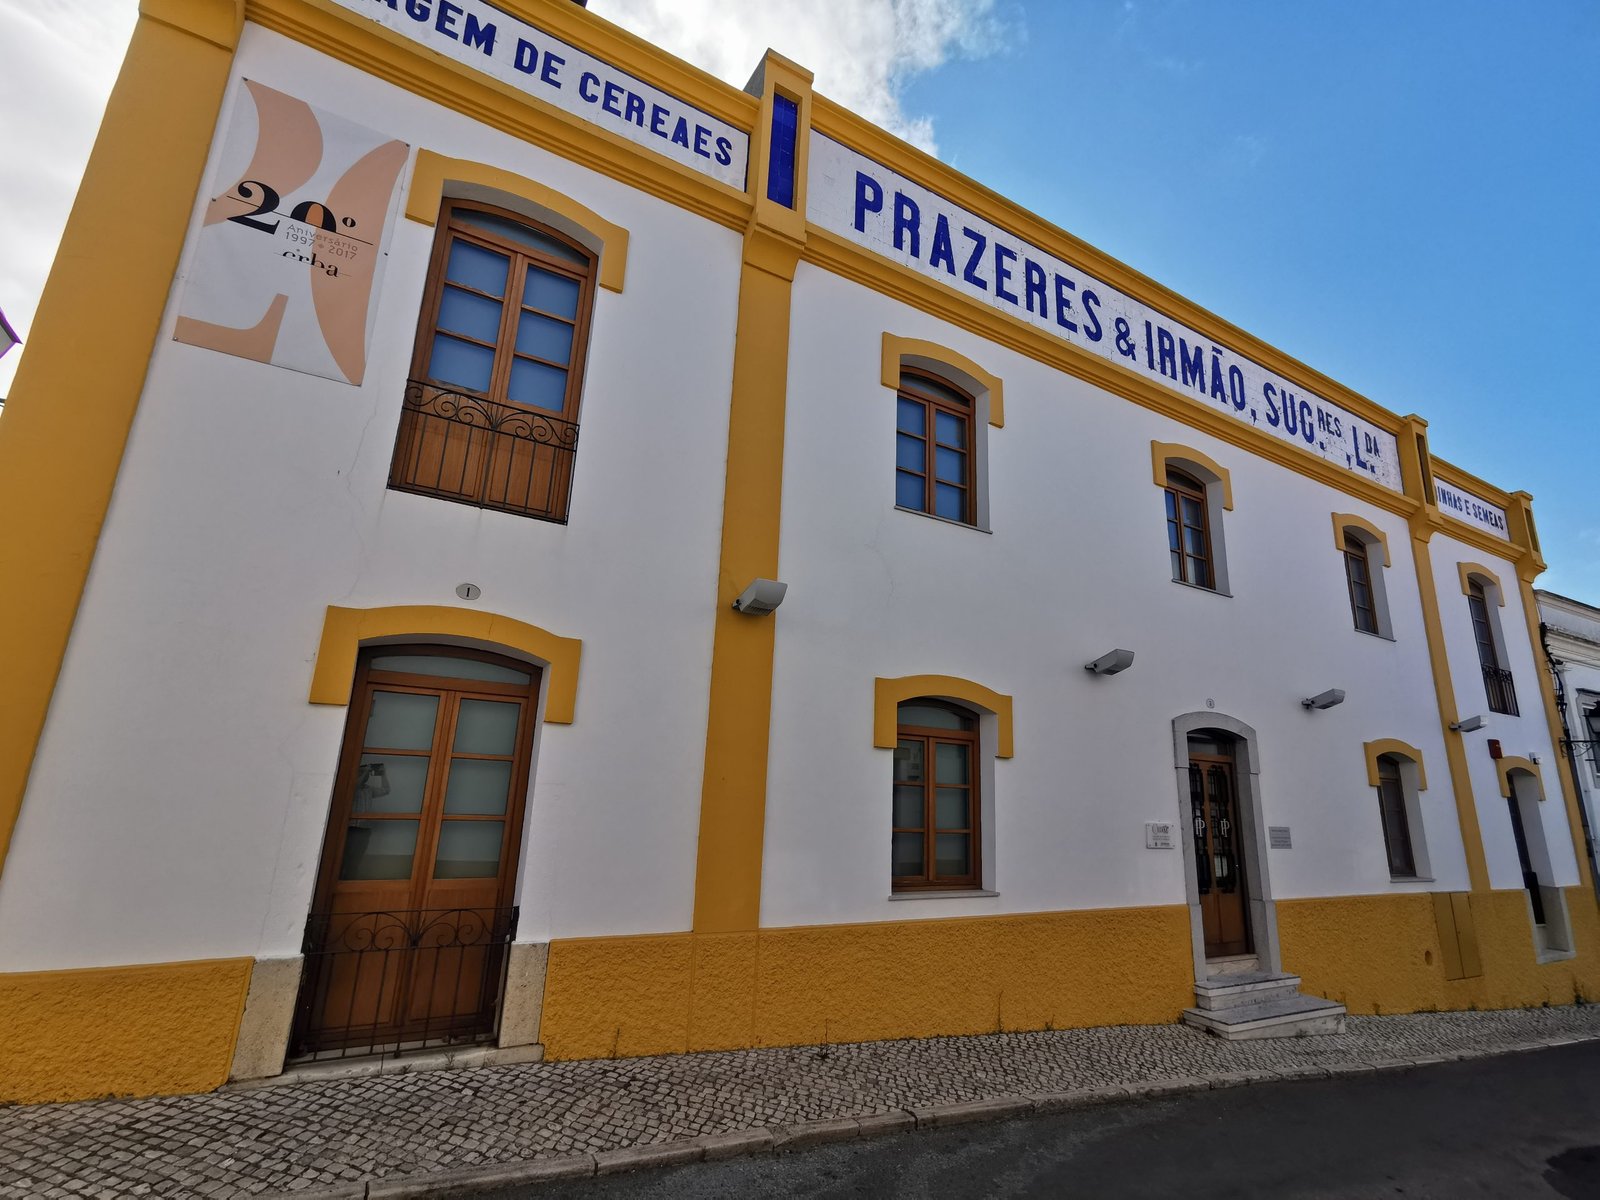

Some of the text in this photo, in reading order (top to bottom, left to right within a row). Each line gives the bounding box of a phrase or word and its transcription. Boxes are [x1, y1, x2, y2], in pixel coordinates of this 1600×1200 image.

[514, 37, 567, 90] DE
[579, 71, 733, 167] CEREAES
[285, 231, 357, 260] 1997 2017
[287, 224, 358, 252] Aniversário
[854, 170, 1102, 342] PRAZERES
[1115, 316, 1137, 362] &
[1145, 319, 1258, 426] IRMÃO,
[1436, 485, 1504, 531] INHAS E SEMEAS
